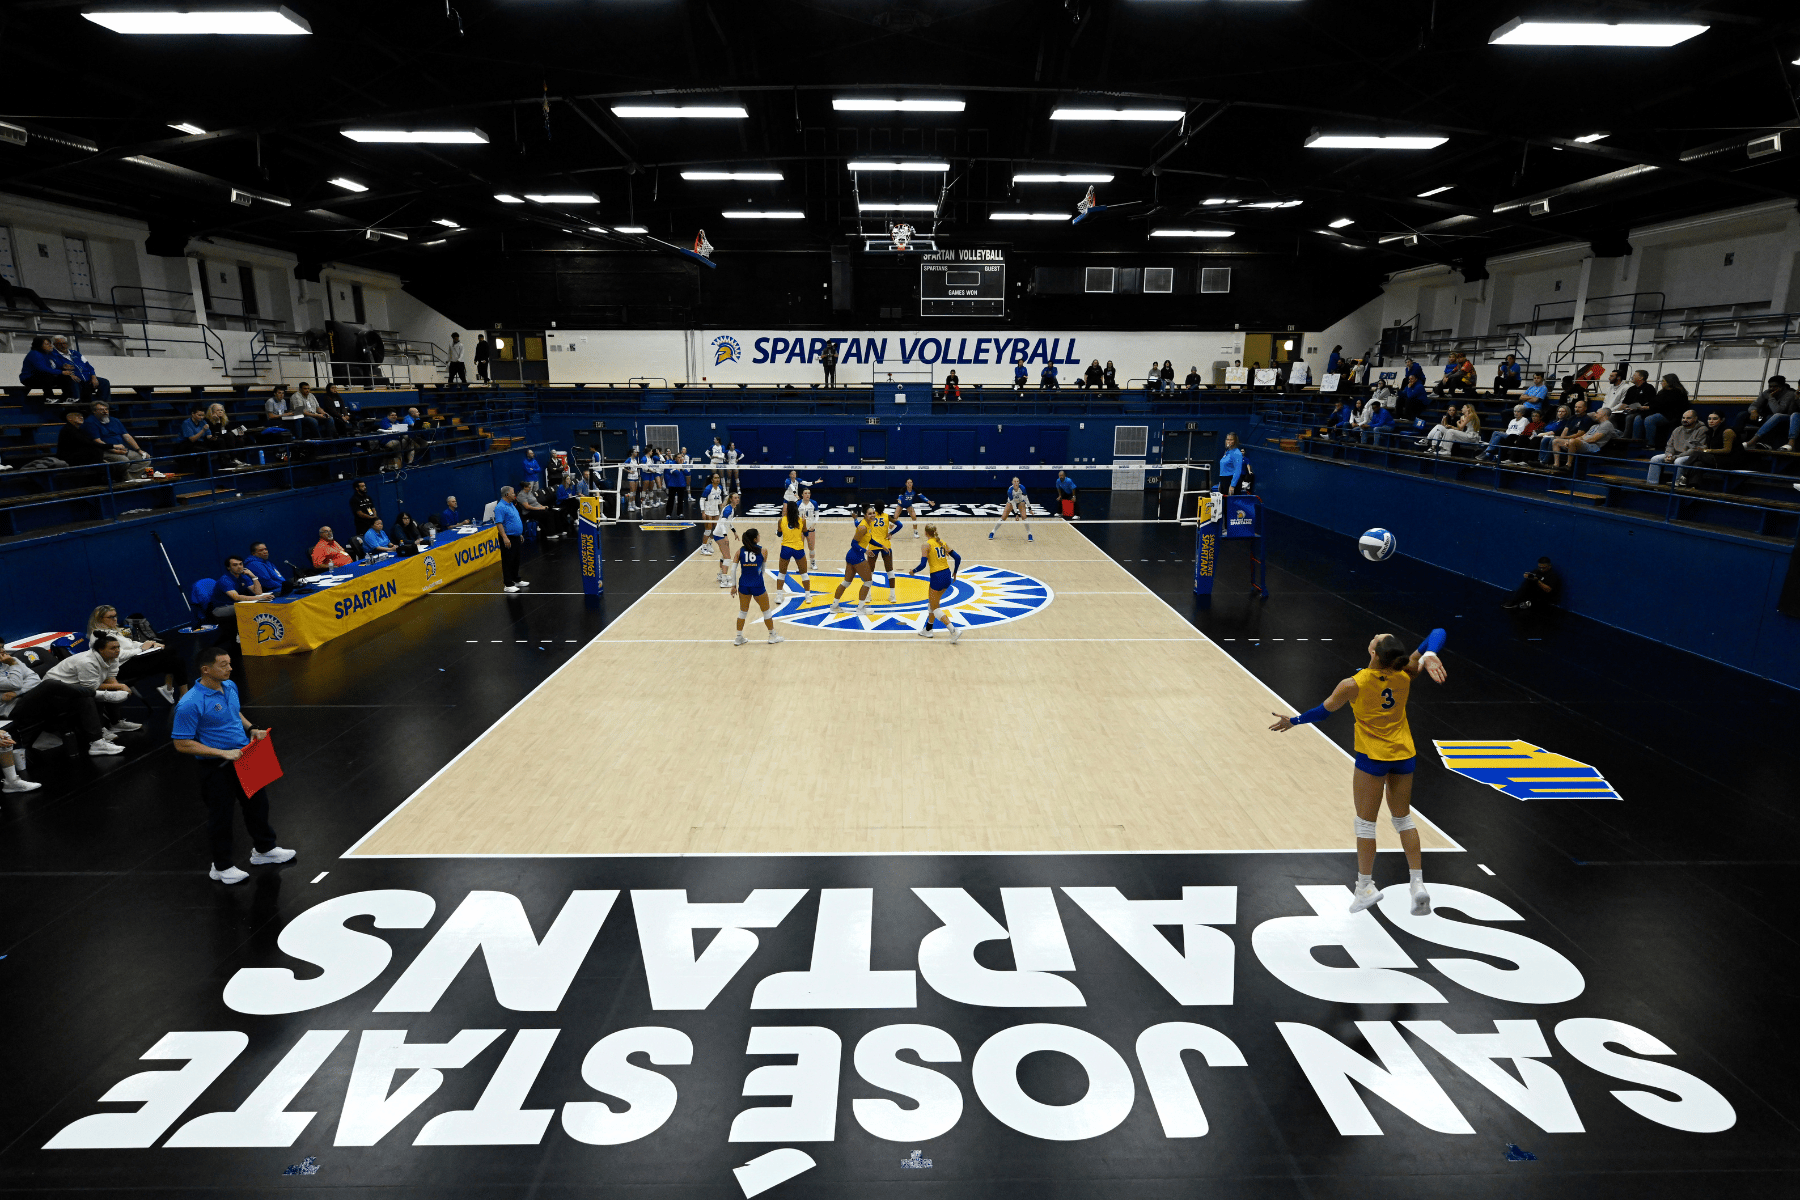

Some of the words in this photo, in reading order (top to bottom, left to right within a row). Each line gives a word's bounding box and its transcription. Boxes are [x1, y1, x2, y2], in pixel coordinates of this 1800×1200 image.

[959, 250, 1003, 260] VOLLEYBALL
[752, 337, 888, 365] SPARTAN
[899, 337, 1081, 365] VOLLEYBALL
[873, 517, 885, 527] 25
[587, 535, 596, 577] SPARTANS
[743, 550, 757, 563] 16
[935, 547, 946, 559] 10
[1200, 534, 1210, 576] SPARTANS
[334, 579, 397, 620] SPARTAN
[1380, 687, 1396, 710] 3
[222, 882, 1586, 1016] SPARTANS
[41, 1026, 694, 1149] STATE
[1275, 1018, 1738, 1136] SAN
[727, 1022, 1249, 1199] JOSÉ
